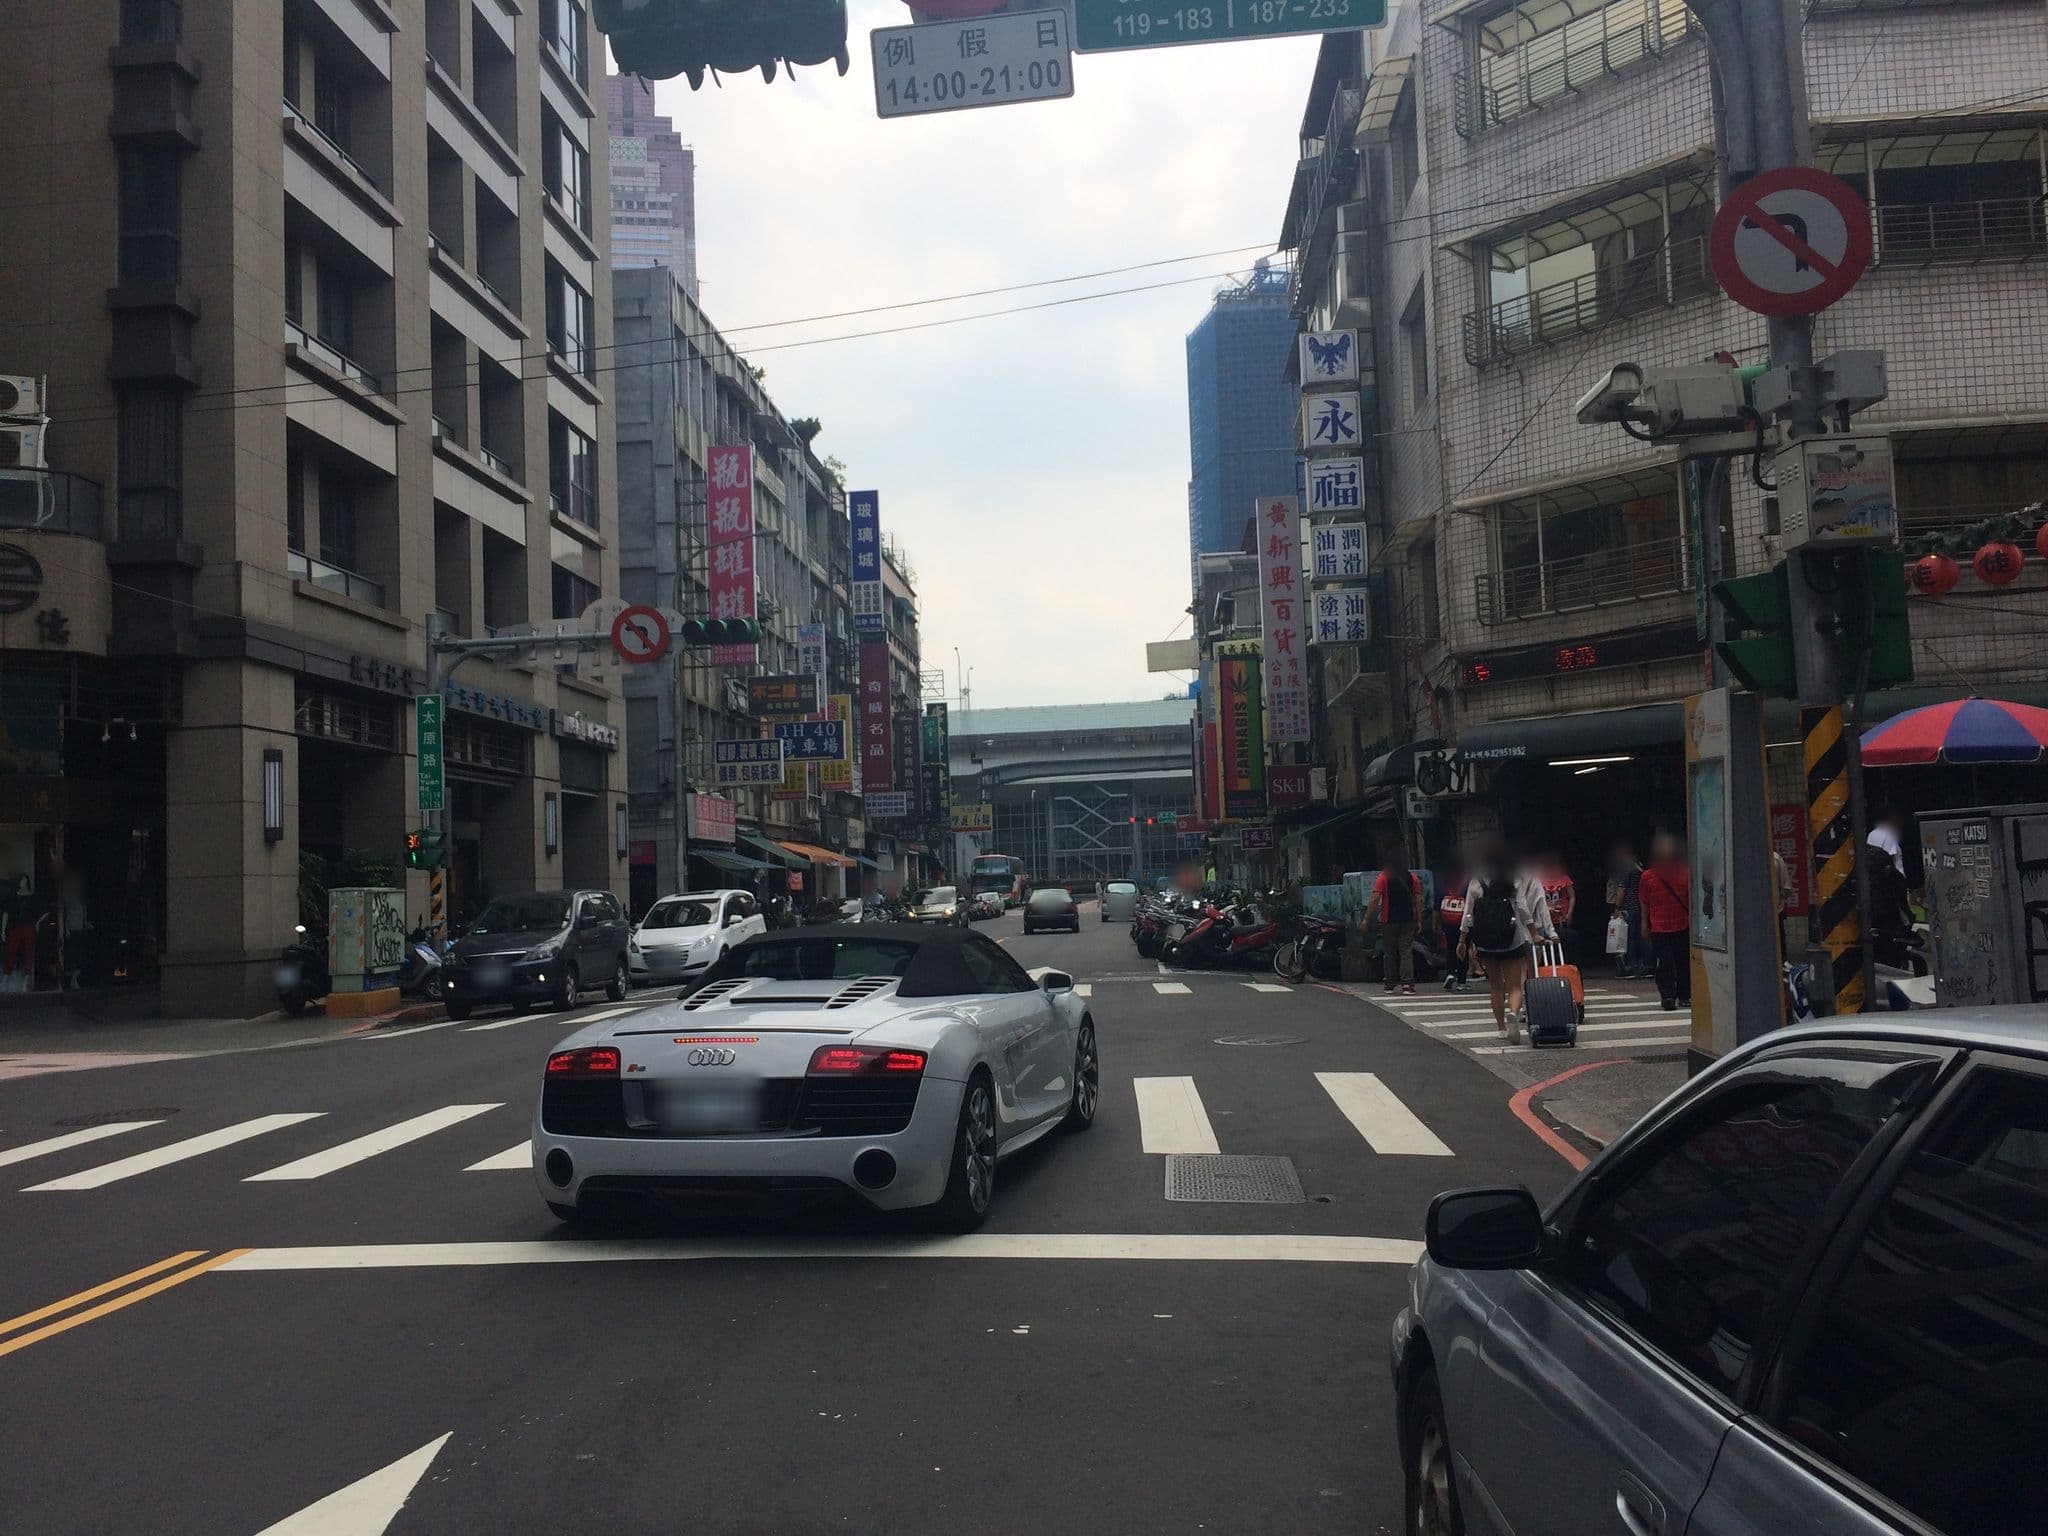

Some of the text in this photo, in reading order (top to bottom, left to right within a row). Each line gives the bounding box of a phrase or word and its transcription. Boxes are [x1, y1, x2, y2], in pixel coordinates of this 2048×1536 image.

[1113, 7, 1213, 37] 119-183
[1248, 0, 1351, 25] 187-233
[884, 18, 1059, 68] 例假日
[887, 60, 1061, 106] 14:00-21:00
[1313, 400, 1359, 508] 永福
[857, 502, 874, 568] 玻璃城
[1317, 530, 1337, 576] 油脂
[1342, 528, 1362, 575] 潤滑
[1319, 596, 1341, 641] 塗料
[1345, 594, 1365, 639] 油漆
[422, 711, 436, 767] 太原路
[814, 723, 836, 737] 40
[1964, 824, 1987, 840] KATSU
